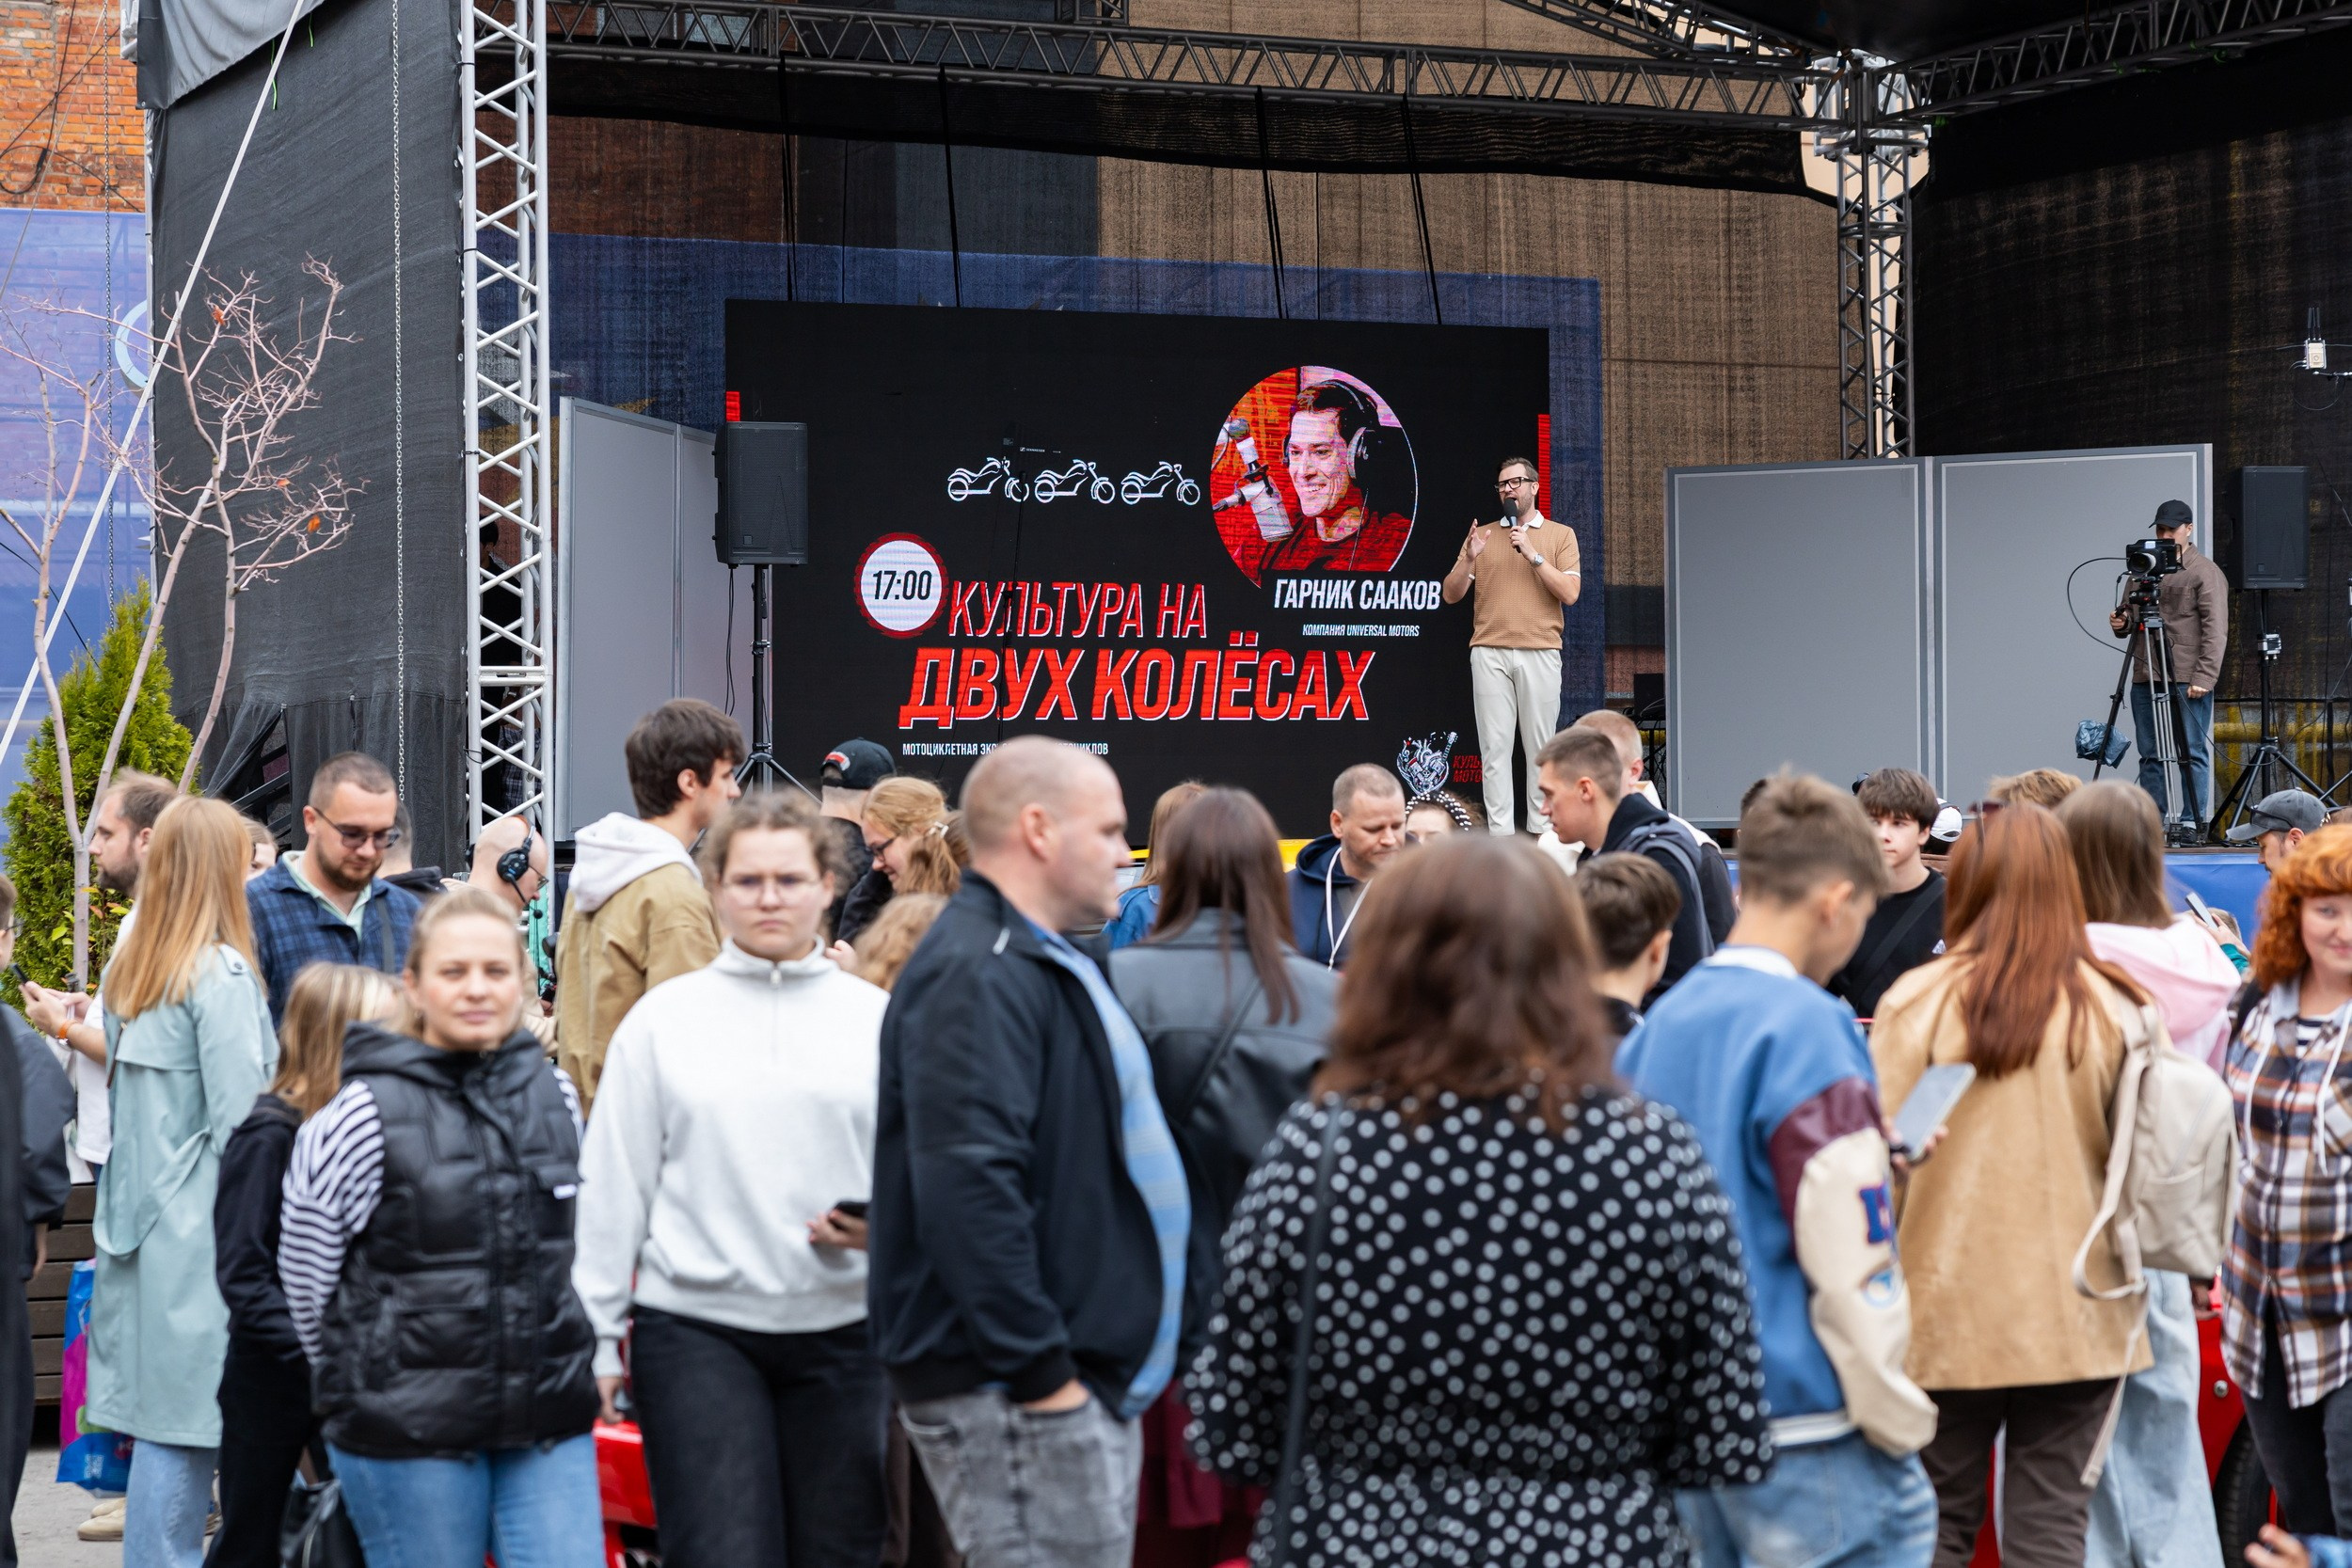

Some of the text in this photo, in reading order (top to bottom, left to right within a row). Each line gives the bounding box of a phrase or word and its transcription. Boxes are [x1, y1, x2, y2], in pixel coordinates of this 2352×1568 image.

[873, 570, 932, 600] 17:00
[1274, 578, 1441, 610] ГАРНИК СААКОВ
[948, 580, 1207, 639] КУЛЬТУРА НА
[1302, 624, 1420, 637] КОМПАНИЯ UNIVERSAL MOTORS
[898, 630, 1376, 729] ДВУХ КОЛЁСАХ
[902, 742, 978, 756] МОТОЦИКЛЕТНАЯ
[1054, 742, 1108, 755] ИКЛОВ
[1453, 754, 1483, 768] КУЛЬ
[1453, 769, 1483, 783] МОТО
